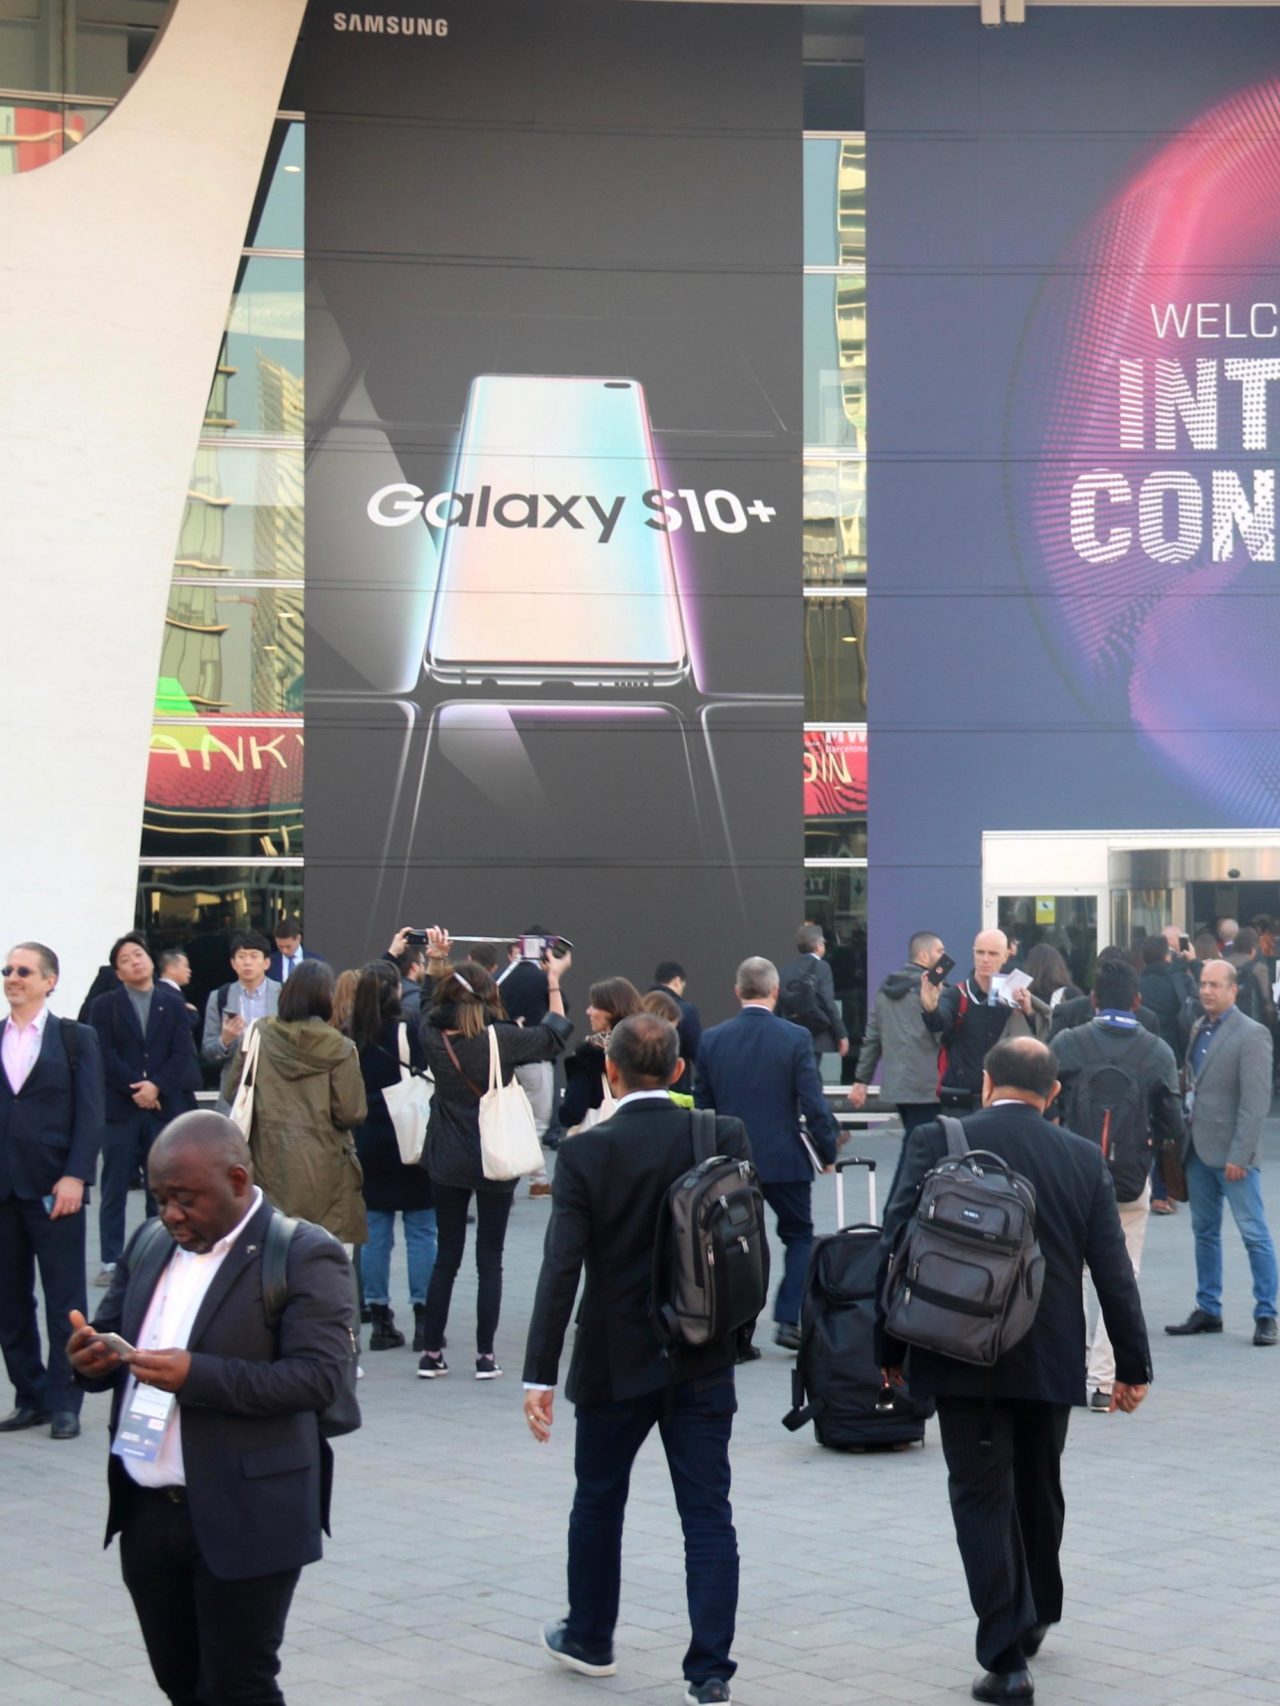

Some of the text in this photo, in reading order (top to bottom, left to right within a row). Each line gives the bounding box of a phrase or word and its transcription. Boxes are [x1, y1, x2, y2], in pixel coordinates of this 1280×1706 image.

[333, 12, 448, 37] SAMSUNG
[366, 482, 777, 544] Galaxy S10+
